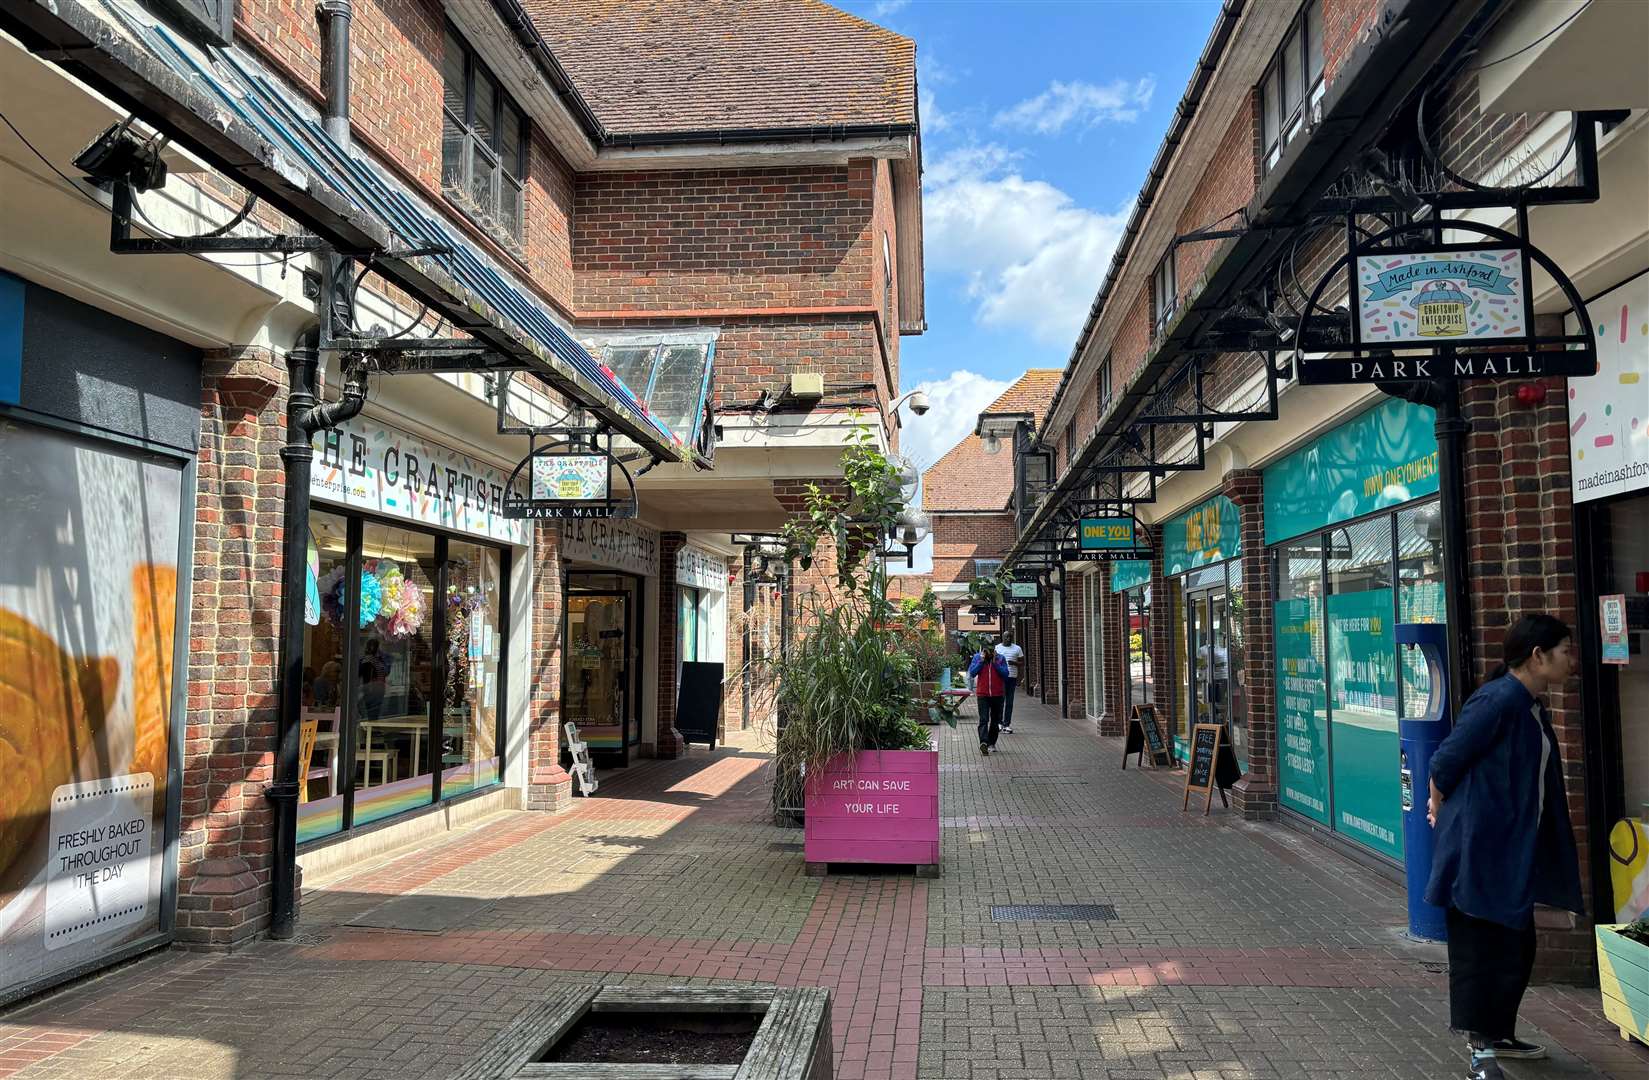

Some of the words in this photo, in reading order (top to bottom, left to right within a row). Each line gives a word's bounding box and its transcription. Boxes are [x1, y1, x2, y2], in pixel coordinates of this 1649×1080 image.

[1388, 267, 1420, 287] Made
[1425, 264, 1438, 275] in
[1441, 263, 1493, 282] Ashford
[1421, 314, 1463, 326] ENTERPRISE
[1424, 304, 1458, 315] CRAFTSHIP
[1351, 360, 1431, 379] PARK
[1454, 356, 1542, 375] MALL
[319, 427, 367, 477] HE
[1578, 461, 1649, 491] madeinashfor
[526, 508, 564, 517] PARK
[572, 508, 613, 518] MALL
[564, 518, 585, 543] HE
[1083, 526, 1106, 538] ONE
[1108, 525, 1131, 537] YOU
[1185, 511, 1202, 553] ONE
[1202, 504, 1221, 546] YOU
[1078, 553, 1104, 561] PARK
[1110, 552, 1139, 560] MALL
[1360, 617, 1370, 632] FOR
[1369, 617, 1382, 632] YOU
[832, 780, 855, 790] ART
[857, 780, 880, 790] CAN
[882, 780, 910, 791] SAVE
[844, 803, 873, 814] YOUR
[877, 803, 900, 814] LIFE
[57, 826, 106, 851] FRESHLY
[108, 818, 145, 840] BAKED
[60, 838, 142, 872] THROUGHOUT
[77, 869, 99, 889] THE
[103, 862, 125, 883] DAY
